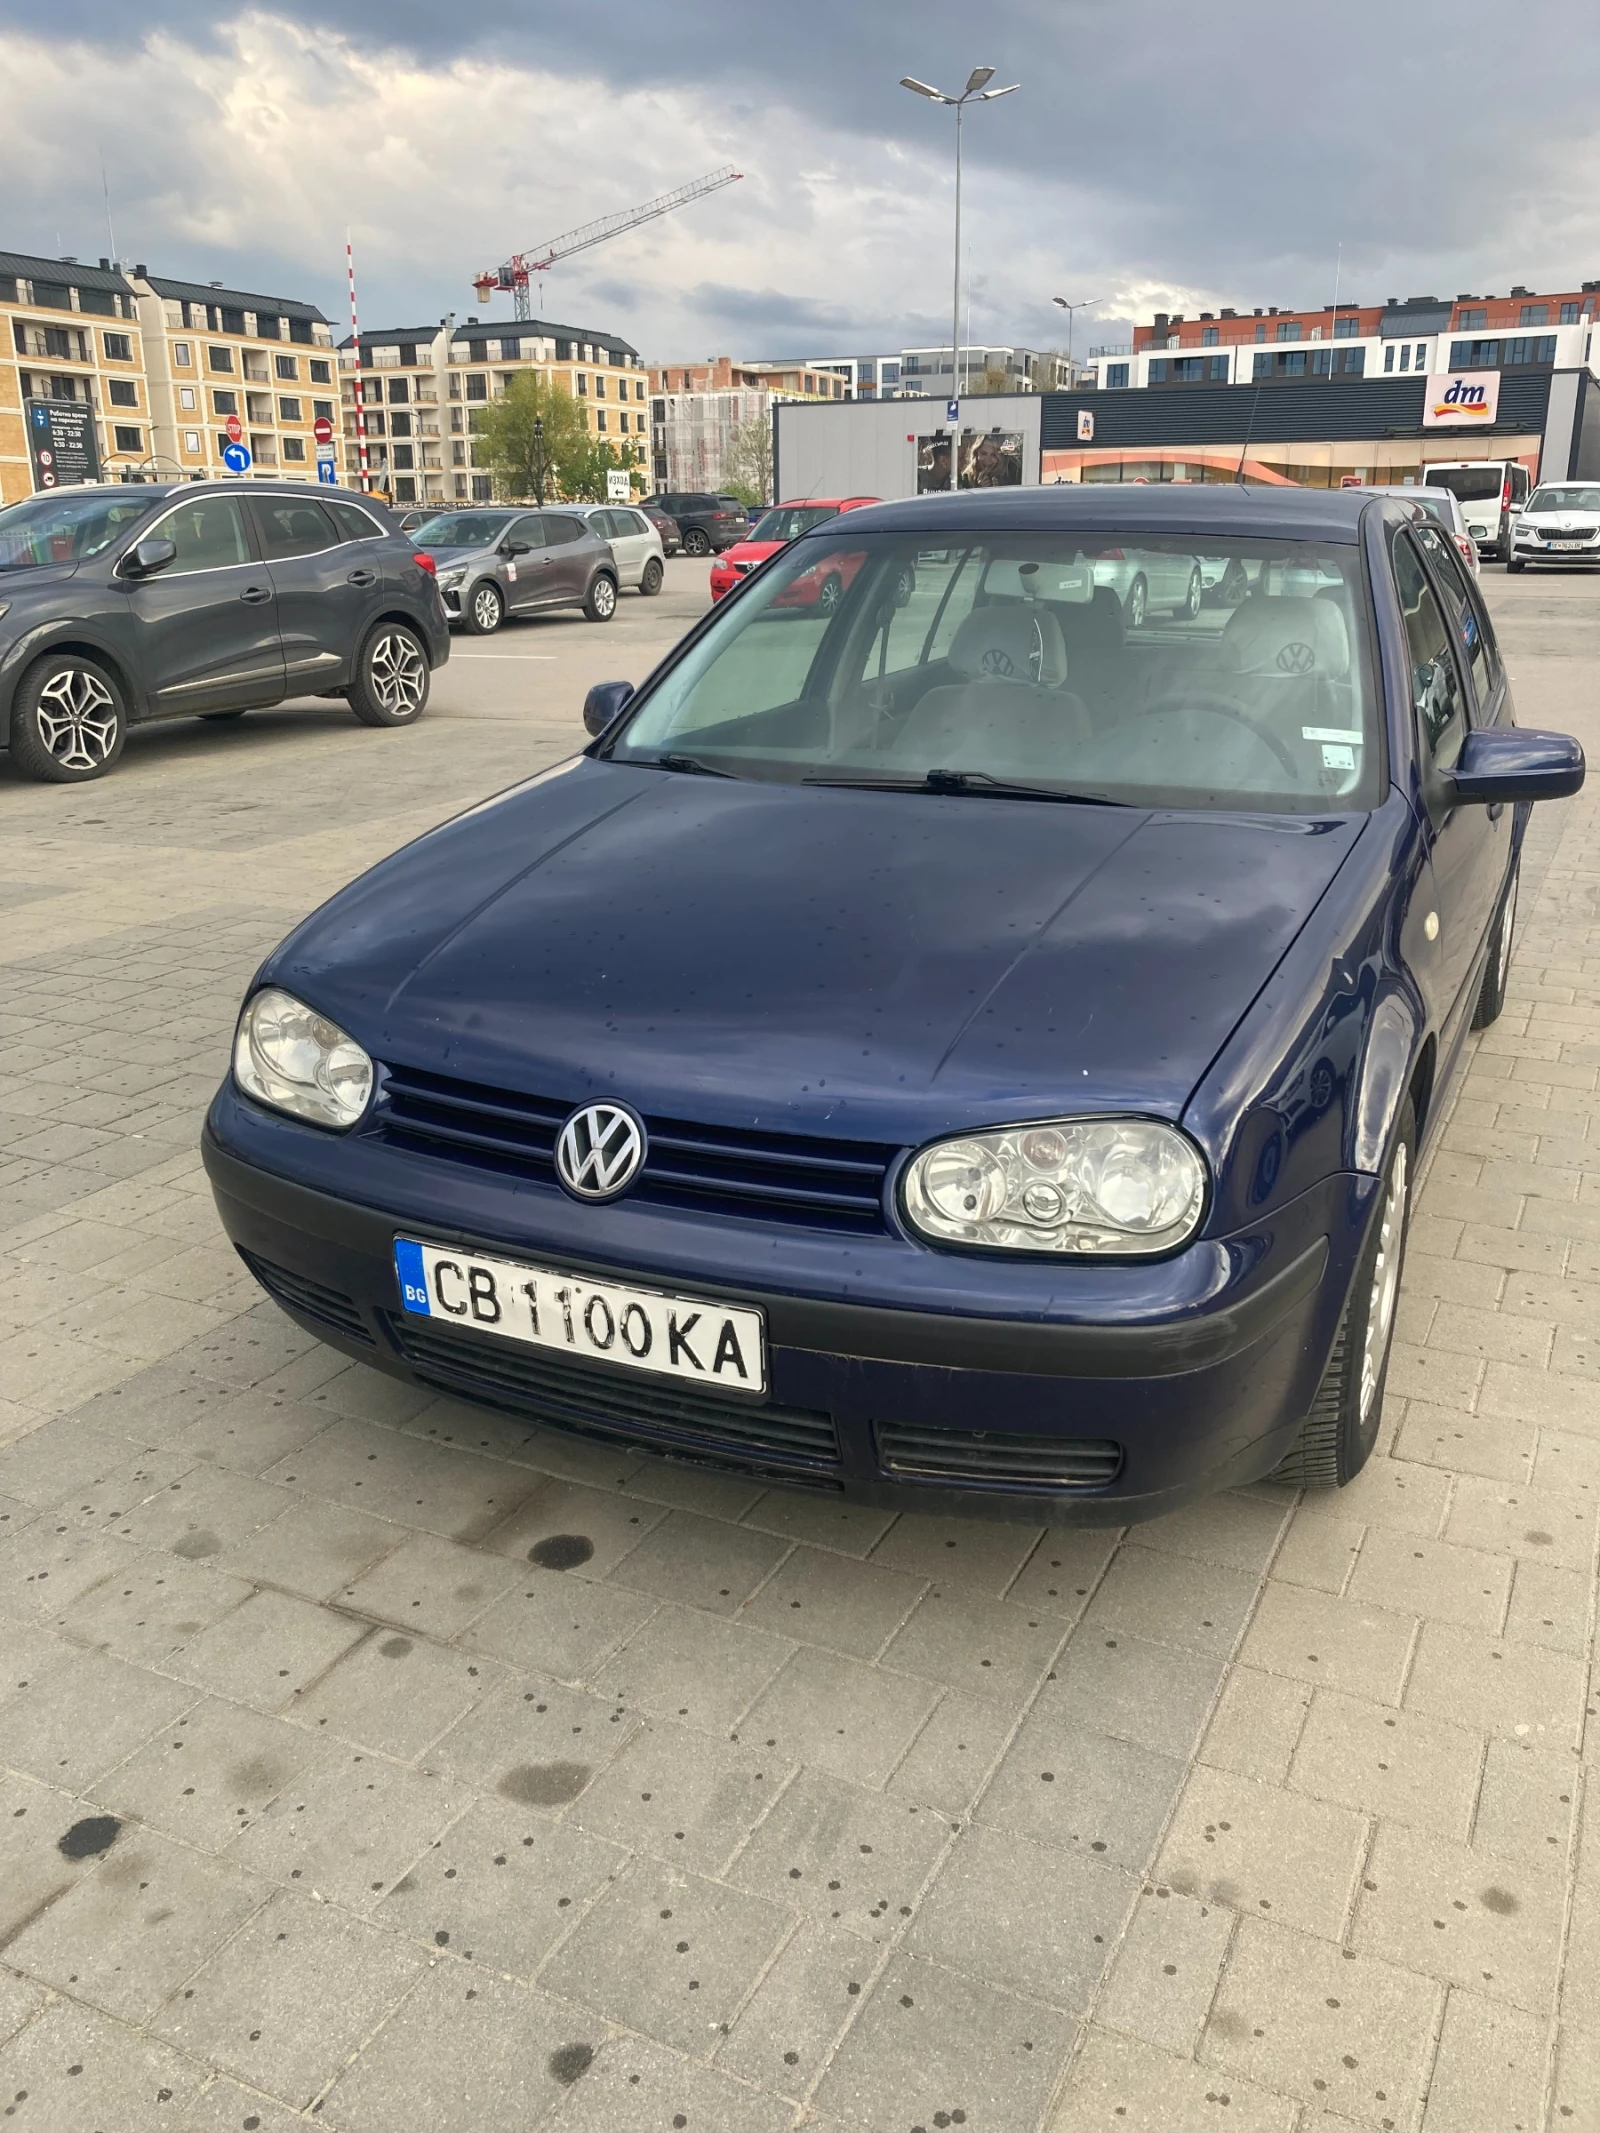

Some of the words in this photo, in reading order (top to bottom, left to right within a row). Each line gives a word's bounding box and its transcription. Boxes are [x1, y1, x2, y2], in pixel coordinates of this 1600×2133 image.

[1444, 380, 1484, 404] dm
[228, 424, 241, 434] STOP
[43, 454, 50, 463] 10
[609, 476, 628, 486] ИЗХОД
[405, 1286, 426, 1304] BG
[434, 1259, 501, 1324] CB
[520, 1279, 652, 1358] 1100
[667, 1308, 748, 1378] KA
